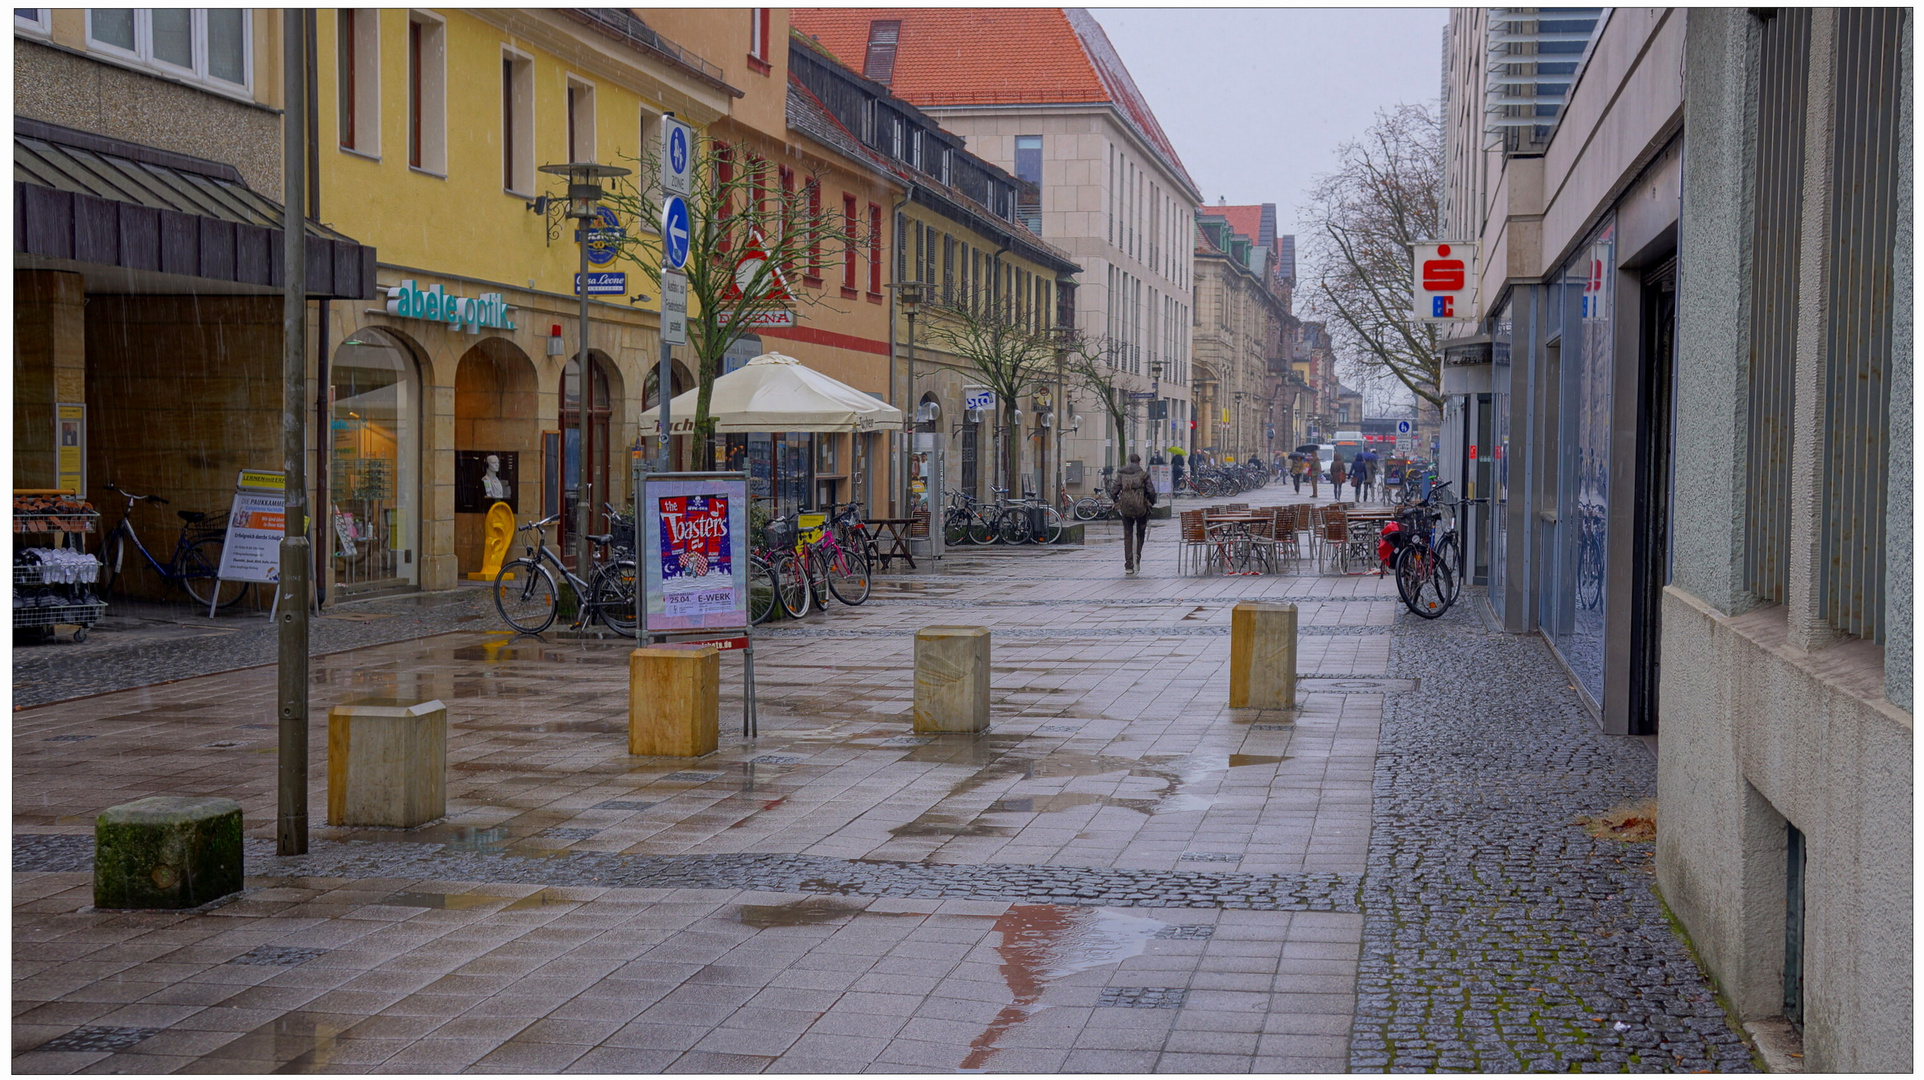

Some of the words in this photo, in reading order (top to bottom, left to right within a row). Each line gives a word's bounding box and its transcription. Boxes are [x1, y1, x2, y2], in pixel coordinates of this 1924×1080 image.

[671, 174, 685, 189] ZONE
[597, 274, 625, 285] Leone
[250, 498, 285, 507] PAUKKAMME
[664, 501, 679, 512] the
[660, 512, 728, 544] Toasters
[670, 595, 692, 604] 25.04.
[697, 592, 731, 602] E-WERK
